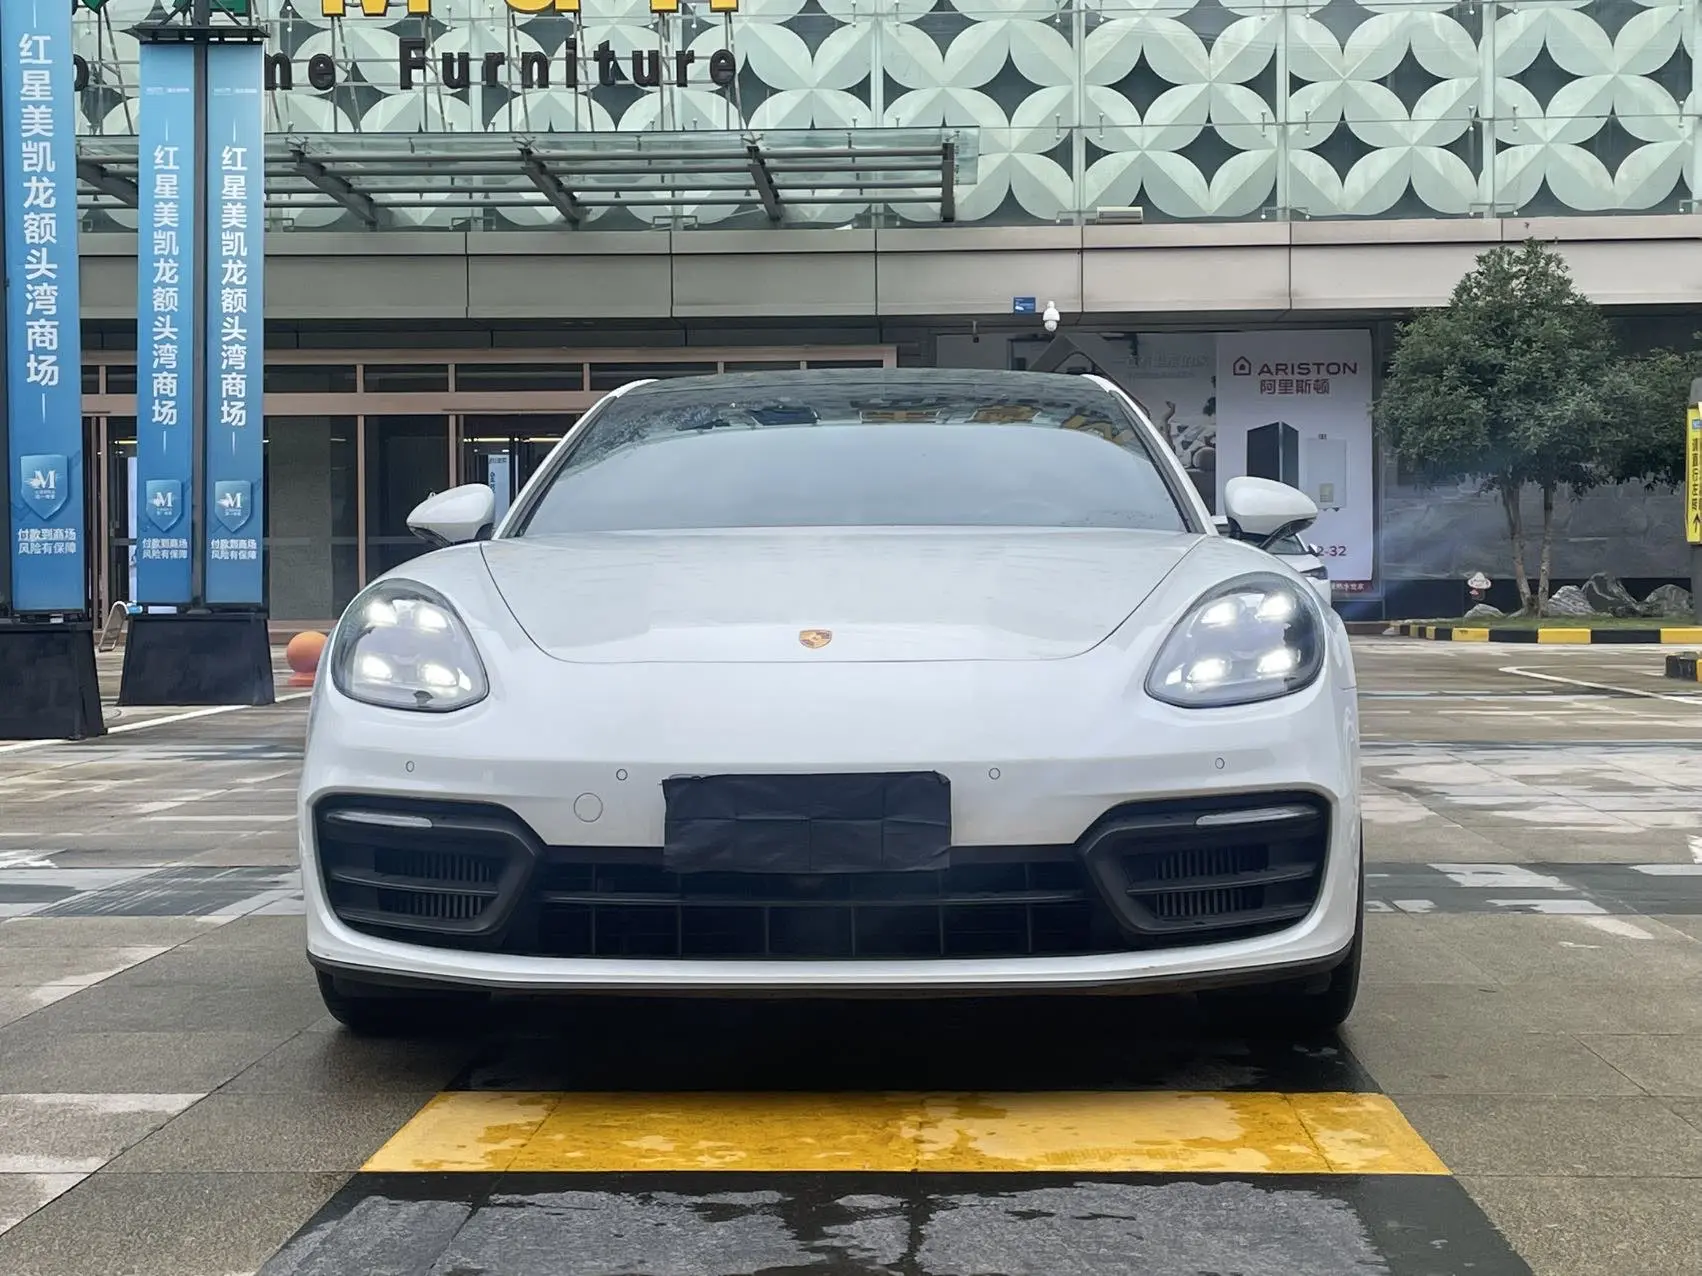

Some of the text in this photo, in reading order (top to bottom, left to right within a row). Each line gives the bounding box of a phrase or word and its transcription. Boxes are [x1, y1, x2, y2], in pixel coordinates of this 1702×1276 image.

[400, 37, 736, 90] Furniture
[19, 33, 59, 387] 红星美凯龙额头湾商场
[152, 145, 180, 426] 红星美凯龙额头湾商场
[221, 146, 248, 427] 红星美凯龙额头湾商场
[1258, 362, 1357, 376] ARISTON
[1260, 379, 1330, 395] 阿里斯顿
